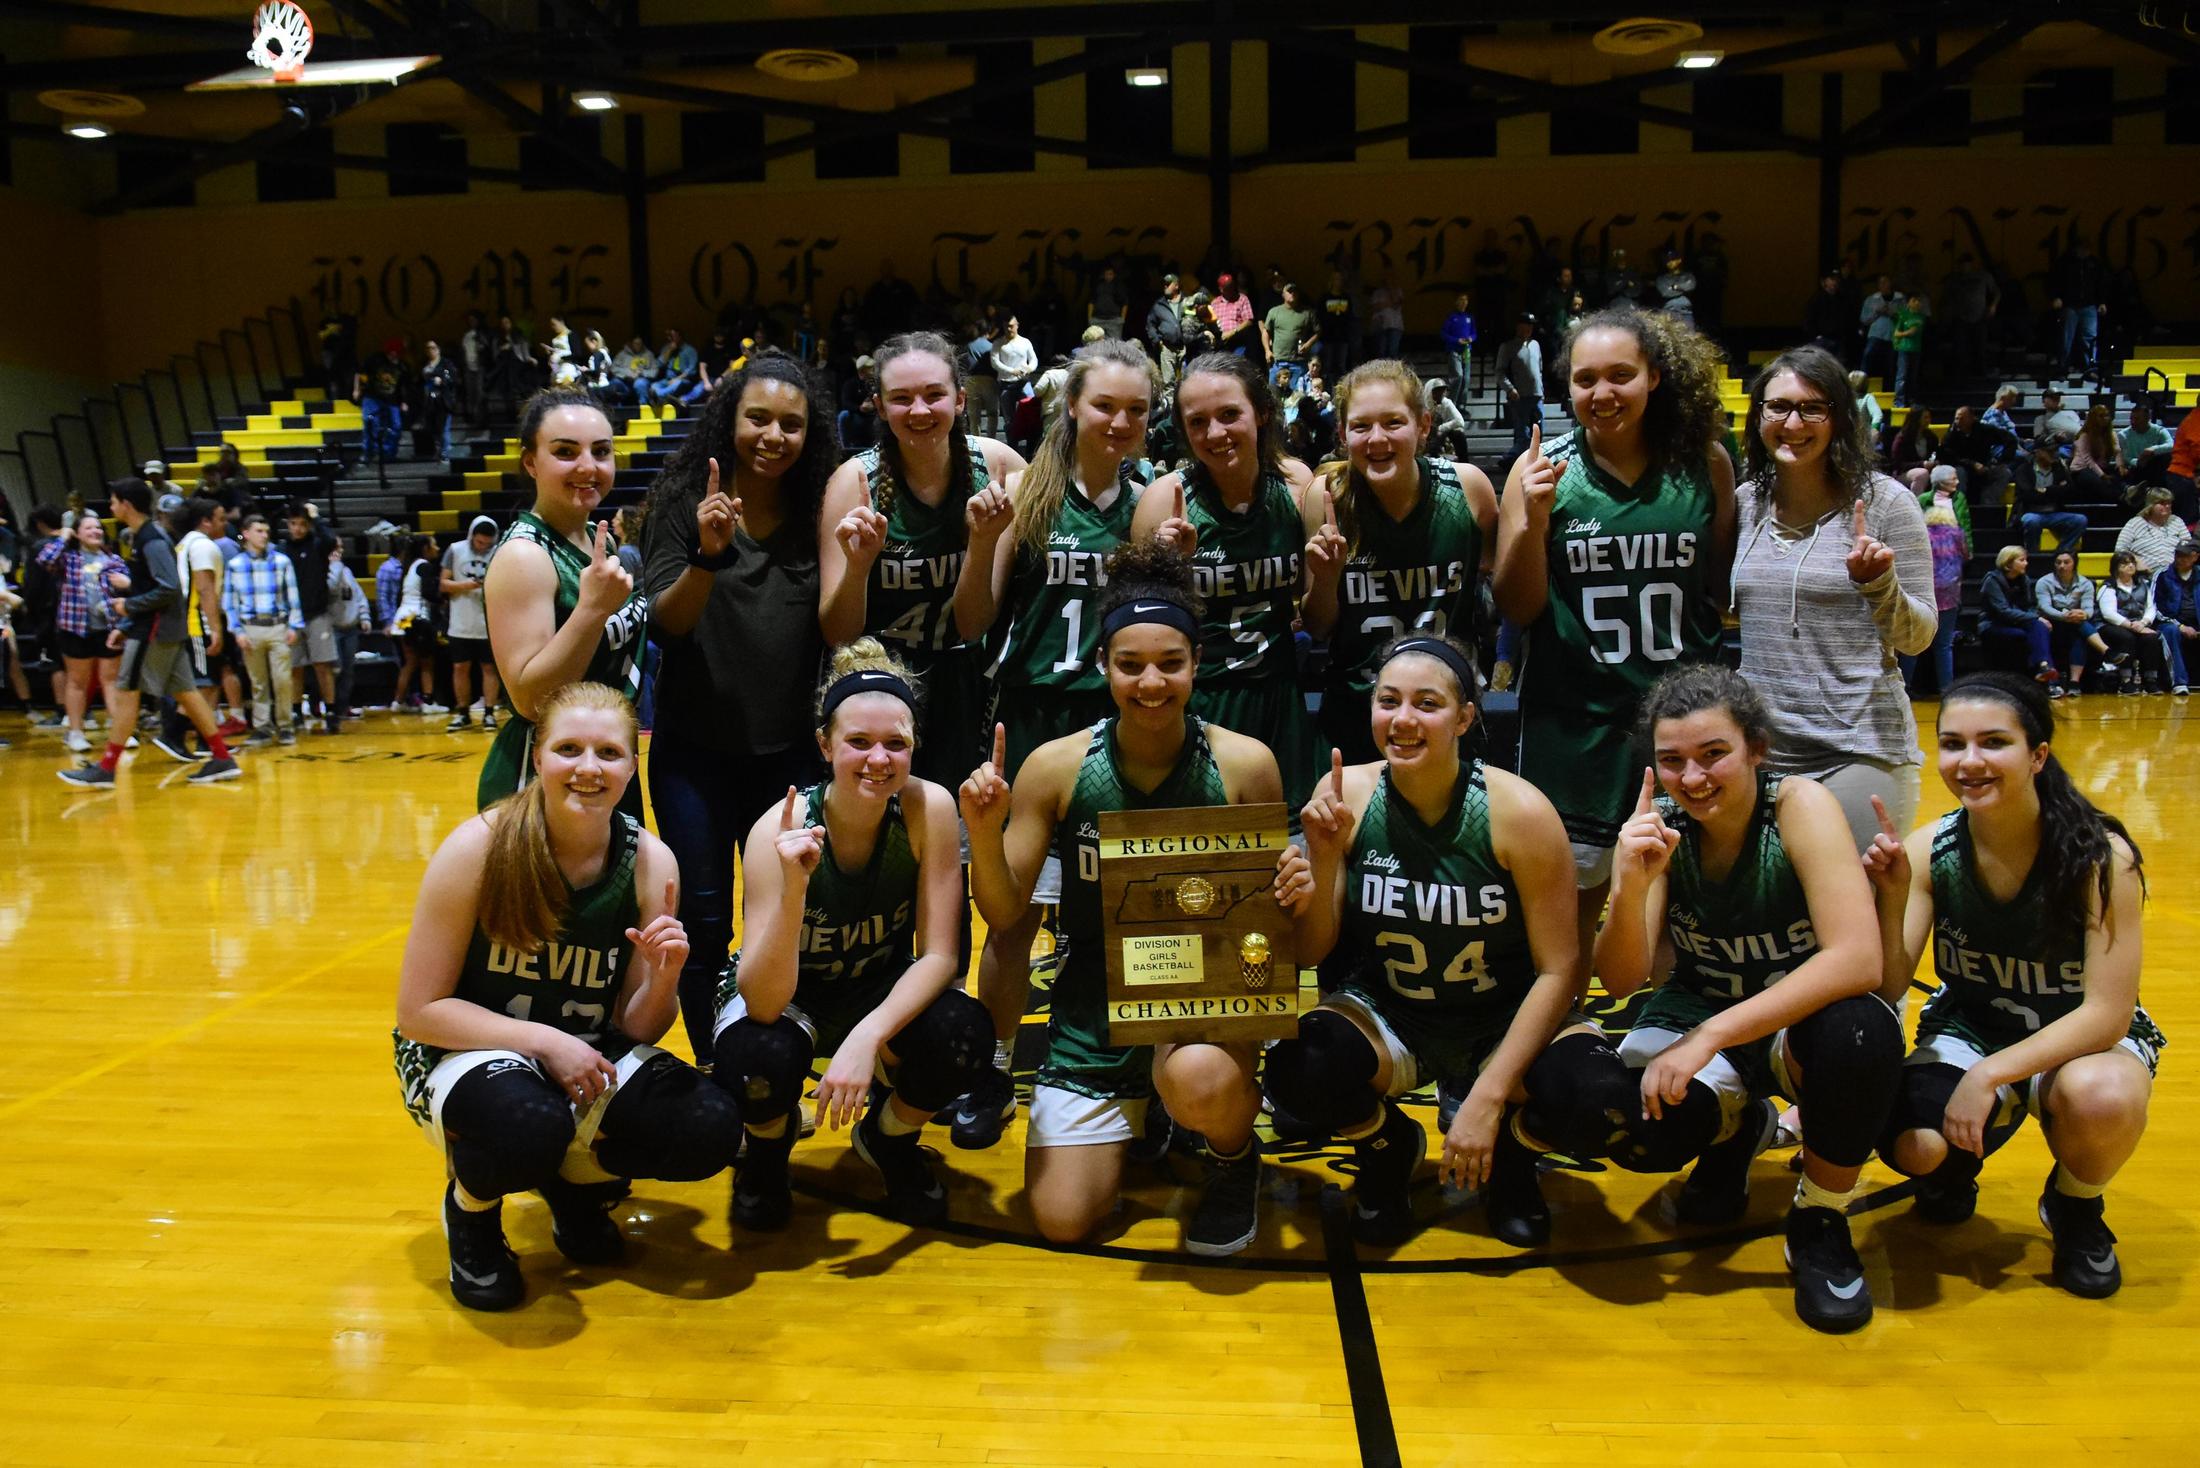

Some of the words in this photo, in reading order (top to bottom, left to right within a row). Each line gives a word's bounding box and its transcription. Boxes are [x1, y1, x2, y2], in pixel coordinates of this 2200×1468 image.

[311, 244, 610, 321] HOME
[690, 235, 838, 314] OF
[1048, 531, 1080, 549] Lady
[1565, 518, 1601, 535] Lady
[1192, 546, 1226, 563] Lady
[1345, 552, 1377, 570] Lady
[1566, 532, 1697, 573] DEVILS
[880, 551, 967, 591] DEVI
[1192, 552, 1299, 598] DEVILS
[1345, 561, 1464, 605] DEVILS
[1225, 601, 1272, 671] 5
[1582, 582, 1684, 664] 50
[1076, 822, 1099, 839] La
[1122, 833, 1269, 855] REGIONAL
[1363, 850, 1400, 874] Lady
[1362, 874, 1507, 925] DEVILS
[804, 907, 830, 926] ady
[1670, 903, 1699, 930] Lady
[1134, 938, 1181, 949] DIVISION
[1186, 938, 1191, 947] I
[1670, 918, 1817, 964] DEVILS
[487, 941, 620, 989] DEVILS
[1133, 961, 1194, 971] BASKETBALL
[1149, 952, 1177, 961] GIRLS
[1375, 931, 1498, 999] 24
[1938, 938, 2085, 995] DEVILS
[1117, 996, 1287, 1020] CHAMPIONS
